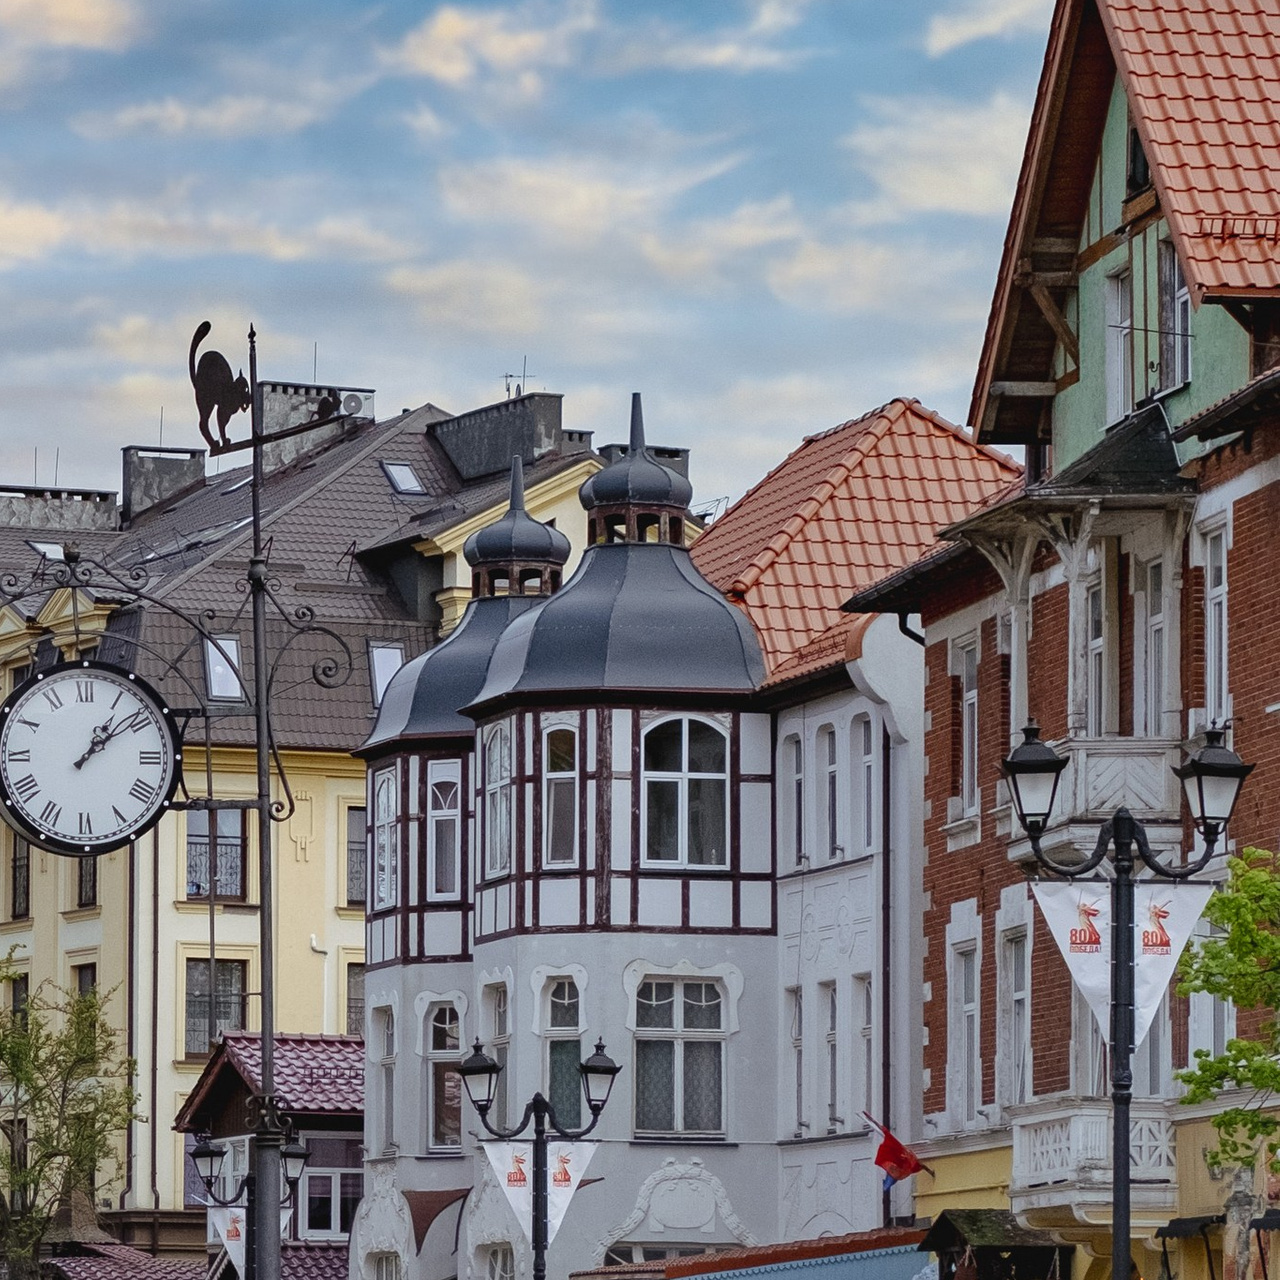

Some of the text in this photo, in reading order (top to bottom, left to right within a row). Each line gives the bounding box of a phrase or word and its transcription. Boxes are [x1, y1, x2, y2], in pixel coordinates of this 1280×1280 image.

[42, 687, 64, 712] XI
[75, 681, 95, 703] XII
[110, 691, 125, 710] I
[17, 714, 40, 734] X
[130, 716, 153, 734] II
[8, 749, 30, 762] IX
[139, 751, 161, 765] III
[13, 774, 41, 804] VIII
[128, 778, 155, 805] IIII
[39, 800, 62, 828] VII
[78, 812, 93, 835] VI
[111, 805, 129, 827] V
[1070, 928, 1088, 944] 80
[1142, 930, 1159, 946] 80
